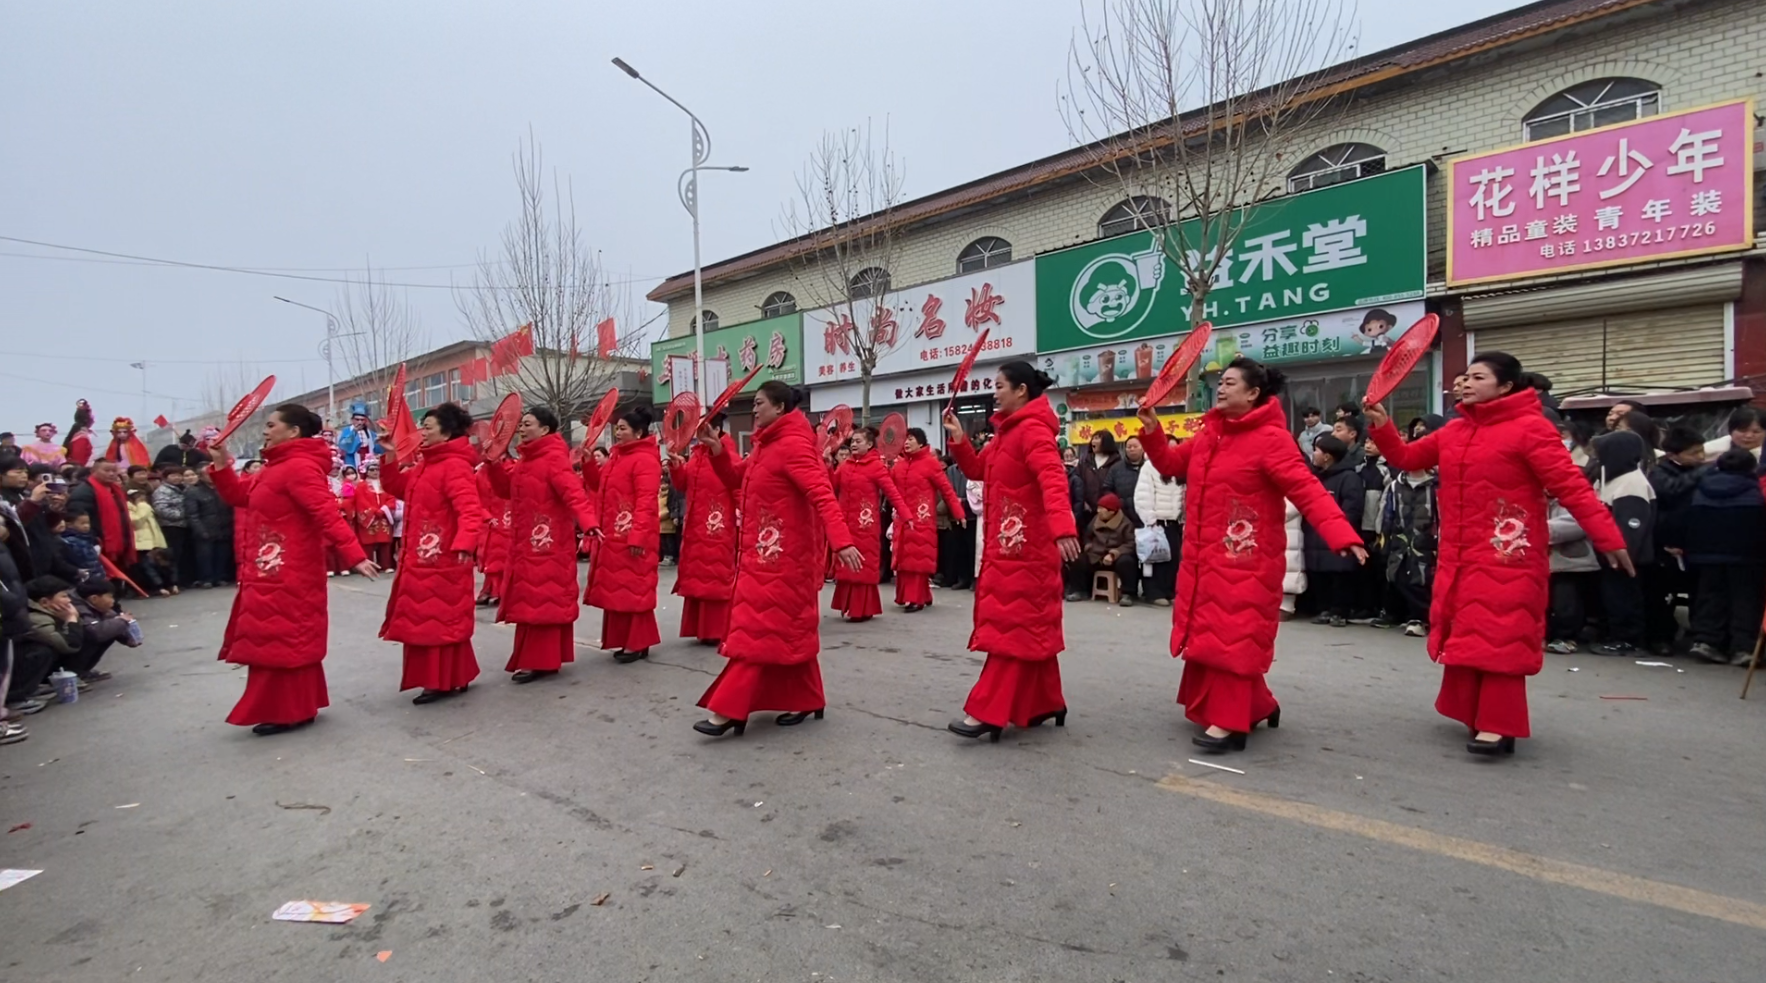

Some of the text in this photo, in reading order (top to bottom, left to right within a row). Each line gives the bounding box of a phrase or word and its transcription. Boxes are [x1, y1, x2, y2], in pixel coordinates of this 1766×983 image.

[1469, 127, 1724, 221] 花样少年
[1470, 189, 1722, 249] 精品童装 青年装
[1540, 221, 1716, 259] 电话 13837217726
[1180, 214, 1367, 295] 益禾堂
[824, 282, 1004, 355] 时尚名妆
[1262, 325, 1297, 343] 分享
[920, 337, 1013, 362] 电话:1582438818
[1262, 337, 1340, 359] 益趣时刻
